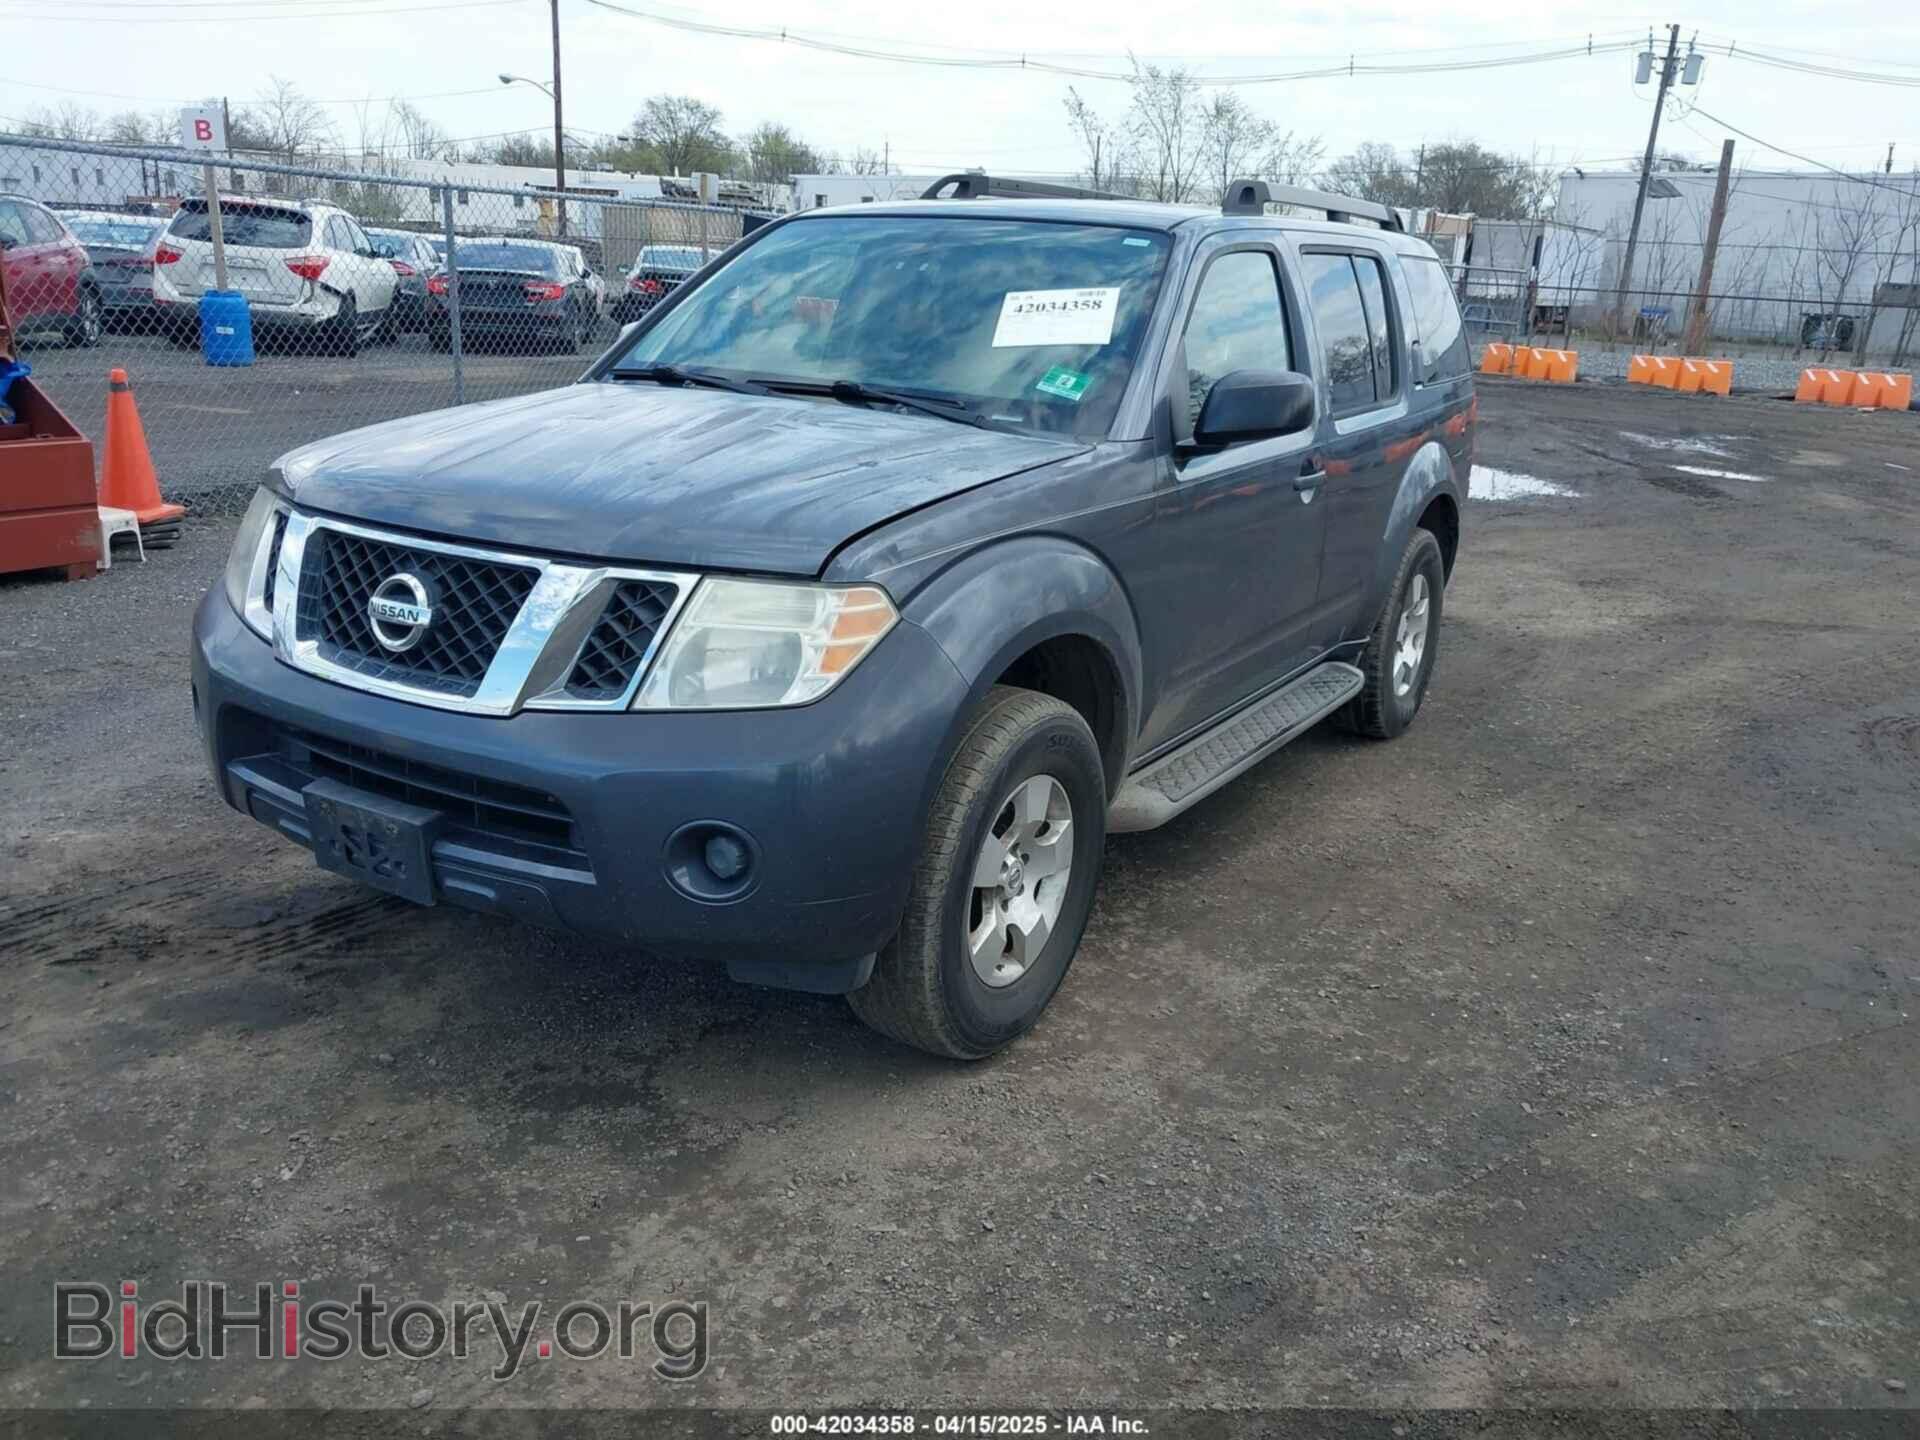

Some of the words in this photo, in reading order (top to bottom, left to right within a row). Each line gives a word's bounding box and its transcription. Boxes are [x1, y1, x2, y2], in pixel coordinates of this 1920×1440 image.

[194, 119, 212, 141] B
[1014, 300, 1102, 313] 42034358
[370, 600, 420, 622] NISSAN
